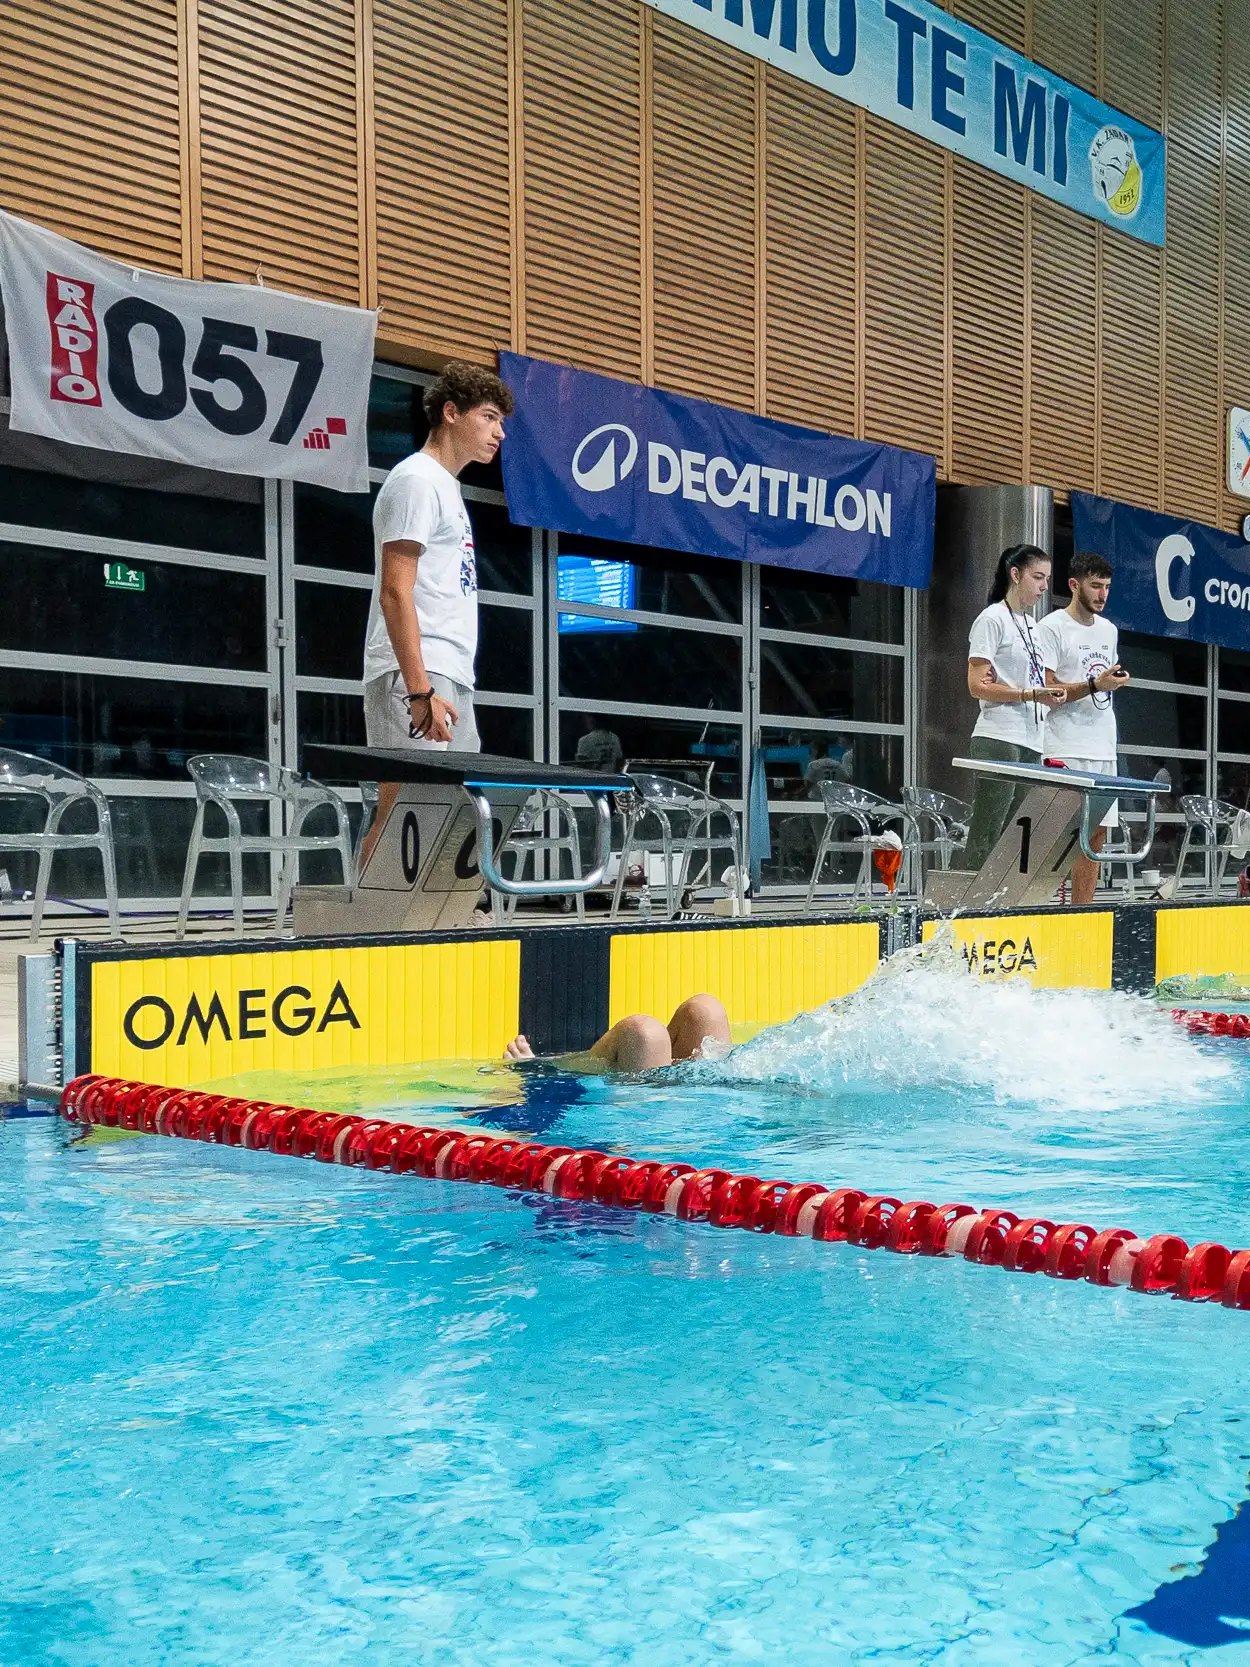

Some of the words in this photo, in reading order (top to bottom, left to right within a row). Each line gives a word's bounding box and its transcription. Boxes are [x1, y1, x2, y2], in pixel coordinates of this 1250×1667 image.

[885, 1, 967, 137] TE
[994, 61, 1069, 187] MI
[54, 278, 97, 400] RADIO
[103, 296, 324, 446] 057
[648, 441, 892, 537] DECATHLON
[401, 810, 420, 885] 0
[1016, 816, 1031, 874] 1
[960, 935, 1037, 976] MEGA
[123, 979, 362, 1050] OMEGA
